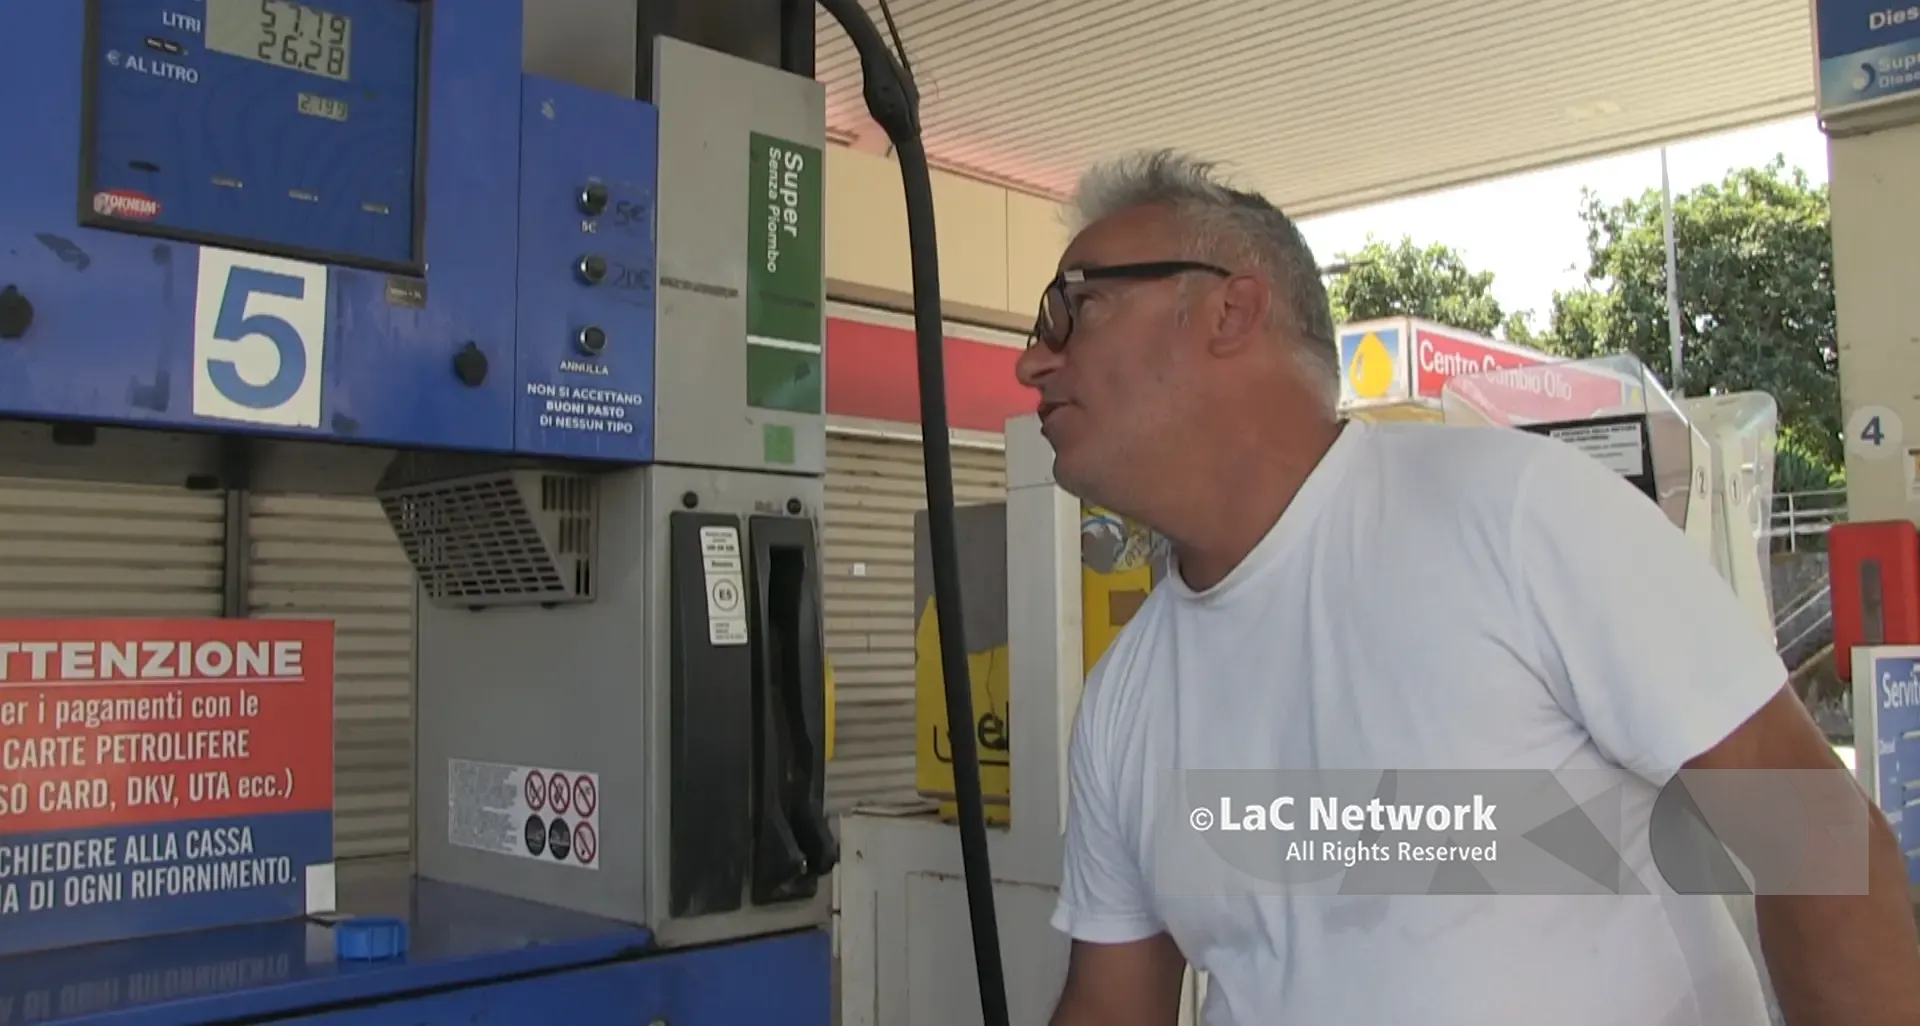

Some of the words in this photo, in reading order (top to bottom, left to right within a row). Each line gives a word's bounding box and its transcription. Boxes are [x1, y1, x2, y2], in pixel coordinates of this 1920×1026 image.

[162, 11, 201, 33] LITRI
[125, 55, 148, 73] AL
[151, 61, 199, 84] LITRO
[258, 30, 345, 76] 26.28
[768, 146, 782, 201] Senza
[779, 150, 804, 239] Super
[767, 203, 781, 273] Piombo
[207, 265, 307, 411] 5
[1419, 338, 1479, 378] Centro
[560, 360, 609, 376] ANNULLA
[527, 383, 556, 397] NON
[558, 386, 570, 398] SI
[572, 388, 643, 405] ACCETTANO
[546, 401, 585, 414] BUONI
[587, 404, 625, 419] PASTO
[540, 414, 552, 427] DI
[555, 416, 604, 431] NESSUN
[606, 421, 633, 434] TIPO
[1860, 415, 1885, 447] 4
[0, 641, 303, 681] TTENZIONE
[38, 693, 45, 724] i
[55, 690, 183, 729] pagamenti
[191, 696, 232, 719] con
[239, 689, 259, 717] le
[3, 735, 87, 770] CARTE
[96, 729, 250, 765] PETROLIFERE
[39, 778, 117, 813] CARD,
[127, 774, 179, 809] DKV,
[189, 771, 231, 801] UTA
[238, 767, 294, 799] ecc.)
[0, 836, 117, 878] CHIEDERE
[124, 832, 178, 865] ALLA
[186, 826, 253, 860] CASSA
[29, 880, 54, 911] DI
[64, 872, 123, 907] OGNI
[131, 856, 297, 900] RIFORNIMENTO.
